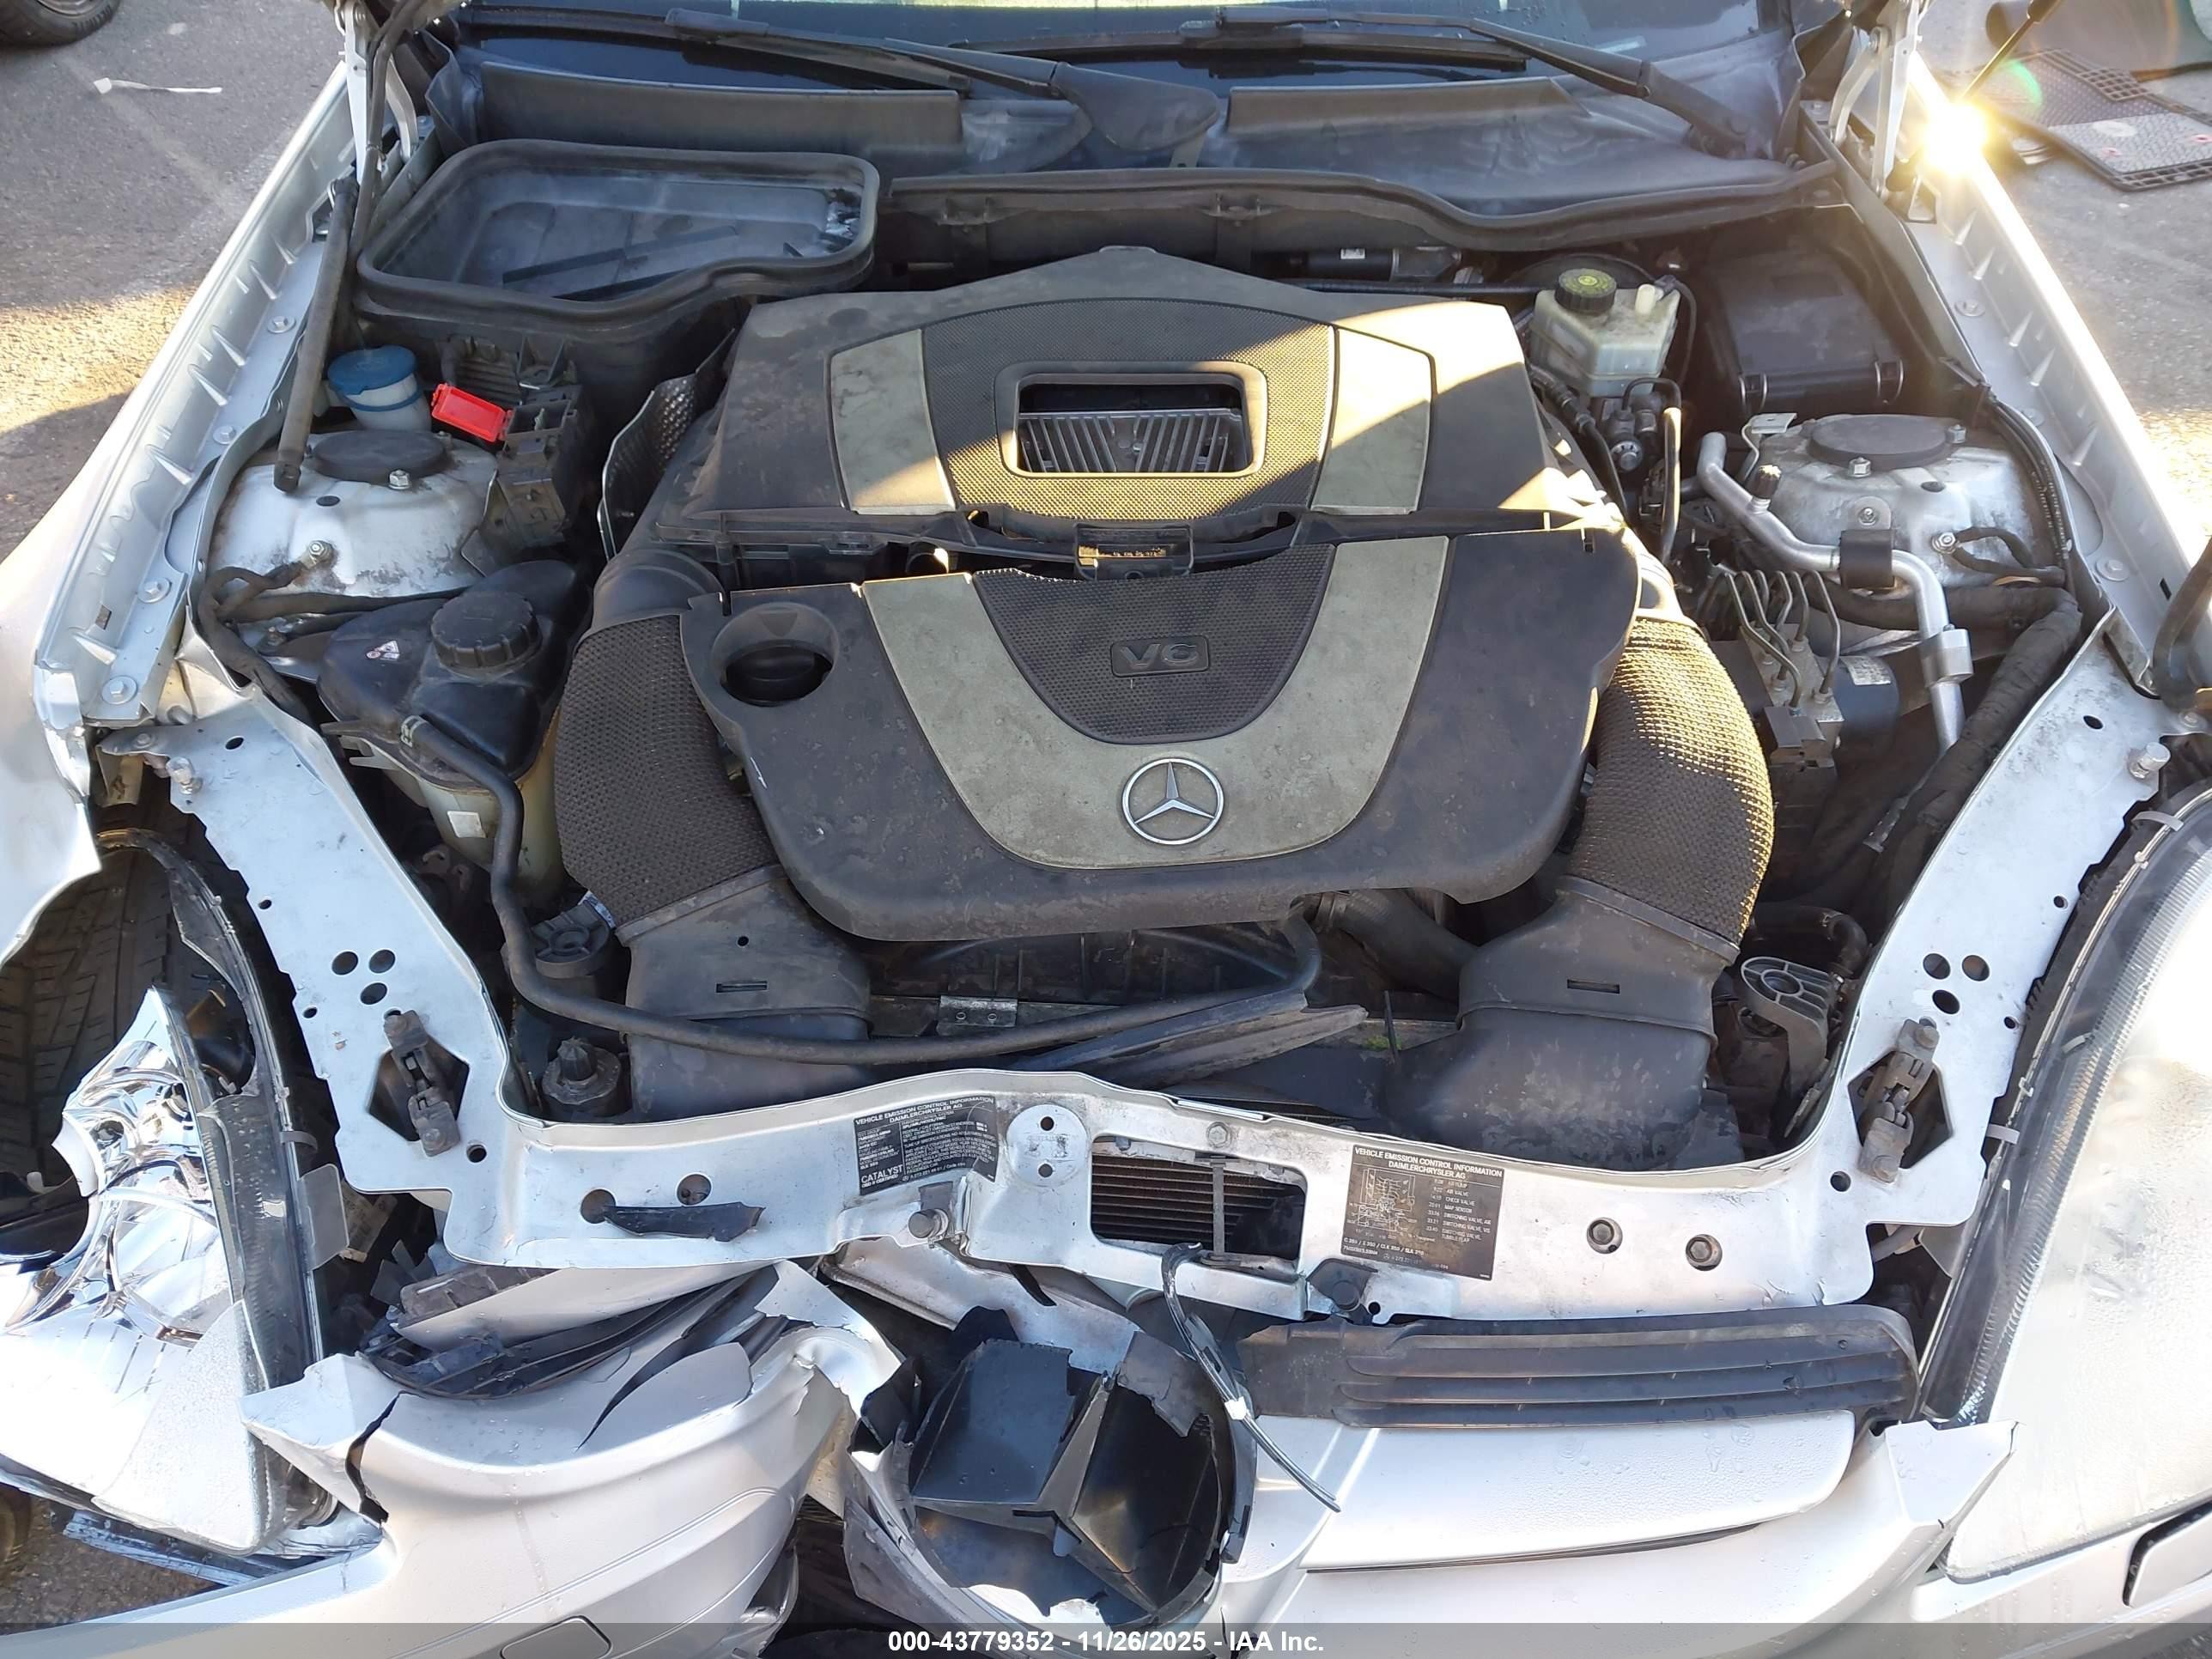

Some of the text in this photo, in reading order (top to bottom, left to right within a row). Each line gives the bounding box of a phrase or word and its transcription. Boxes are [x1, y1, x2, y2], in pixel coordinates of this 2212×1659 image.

[1121, 643, 1199, 669] V6
[855, 1114, 883, 1125] VEHICLE
[884, 1106, 916, 1119] EMISSION
[917, 1102, 948, 1110] CONTROL
[949, 1097, 994, 1105] INFORMATION
[889, 1105, 951, 1123] DAIMLERCHRYSLER
[1355, 1147, 1502, 1177] VEHICLE EMISSION CONTROL INFORMATION
[1389, 1161, 1454, 1178] DAIMLERCHRYSLER
[861, 1164, 902, 1183] CATALYST
[876, 1174, 898, 1183] CERTIFIED
[1443, 1220, 1466, 1229] SWITCHING
